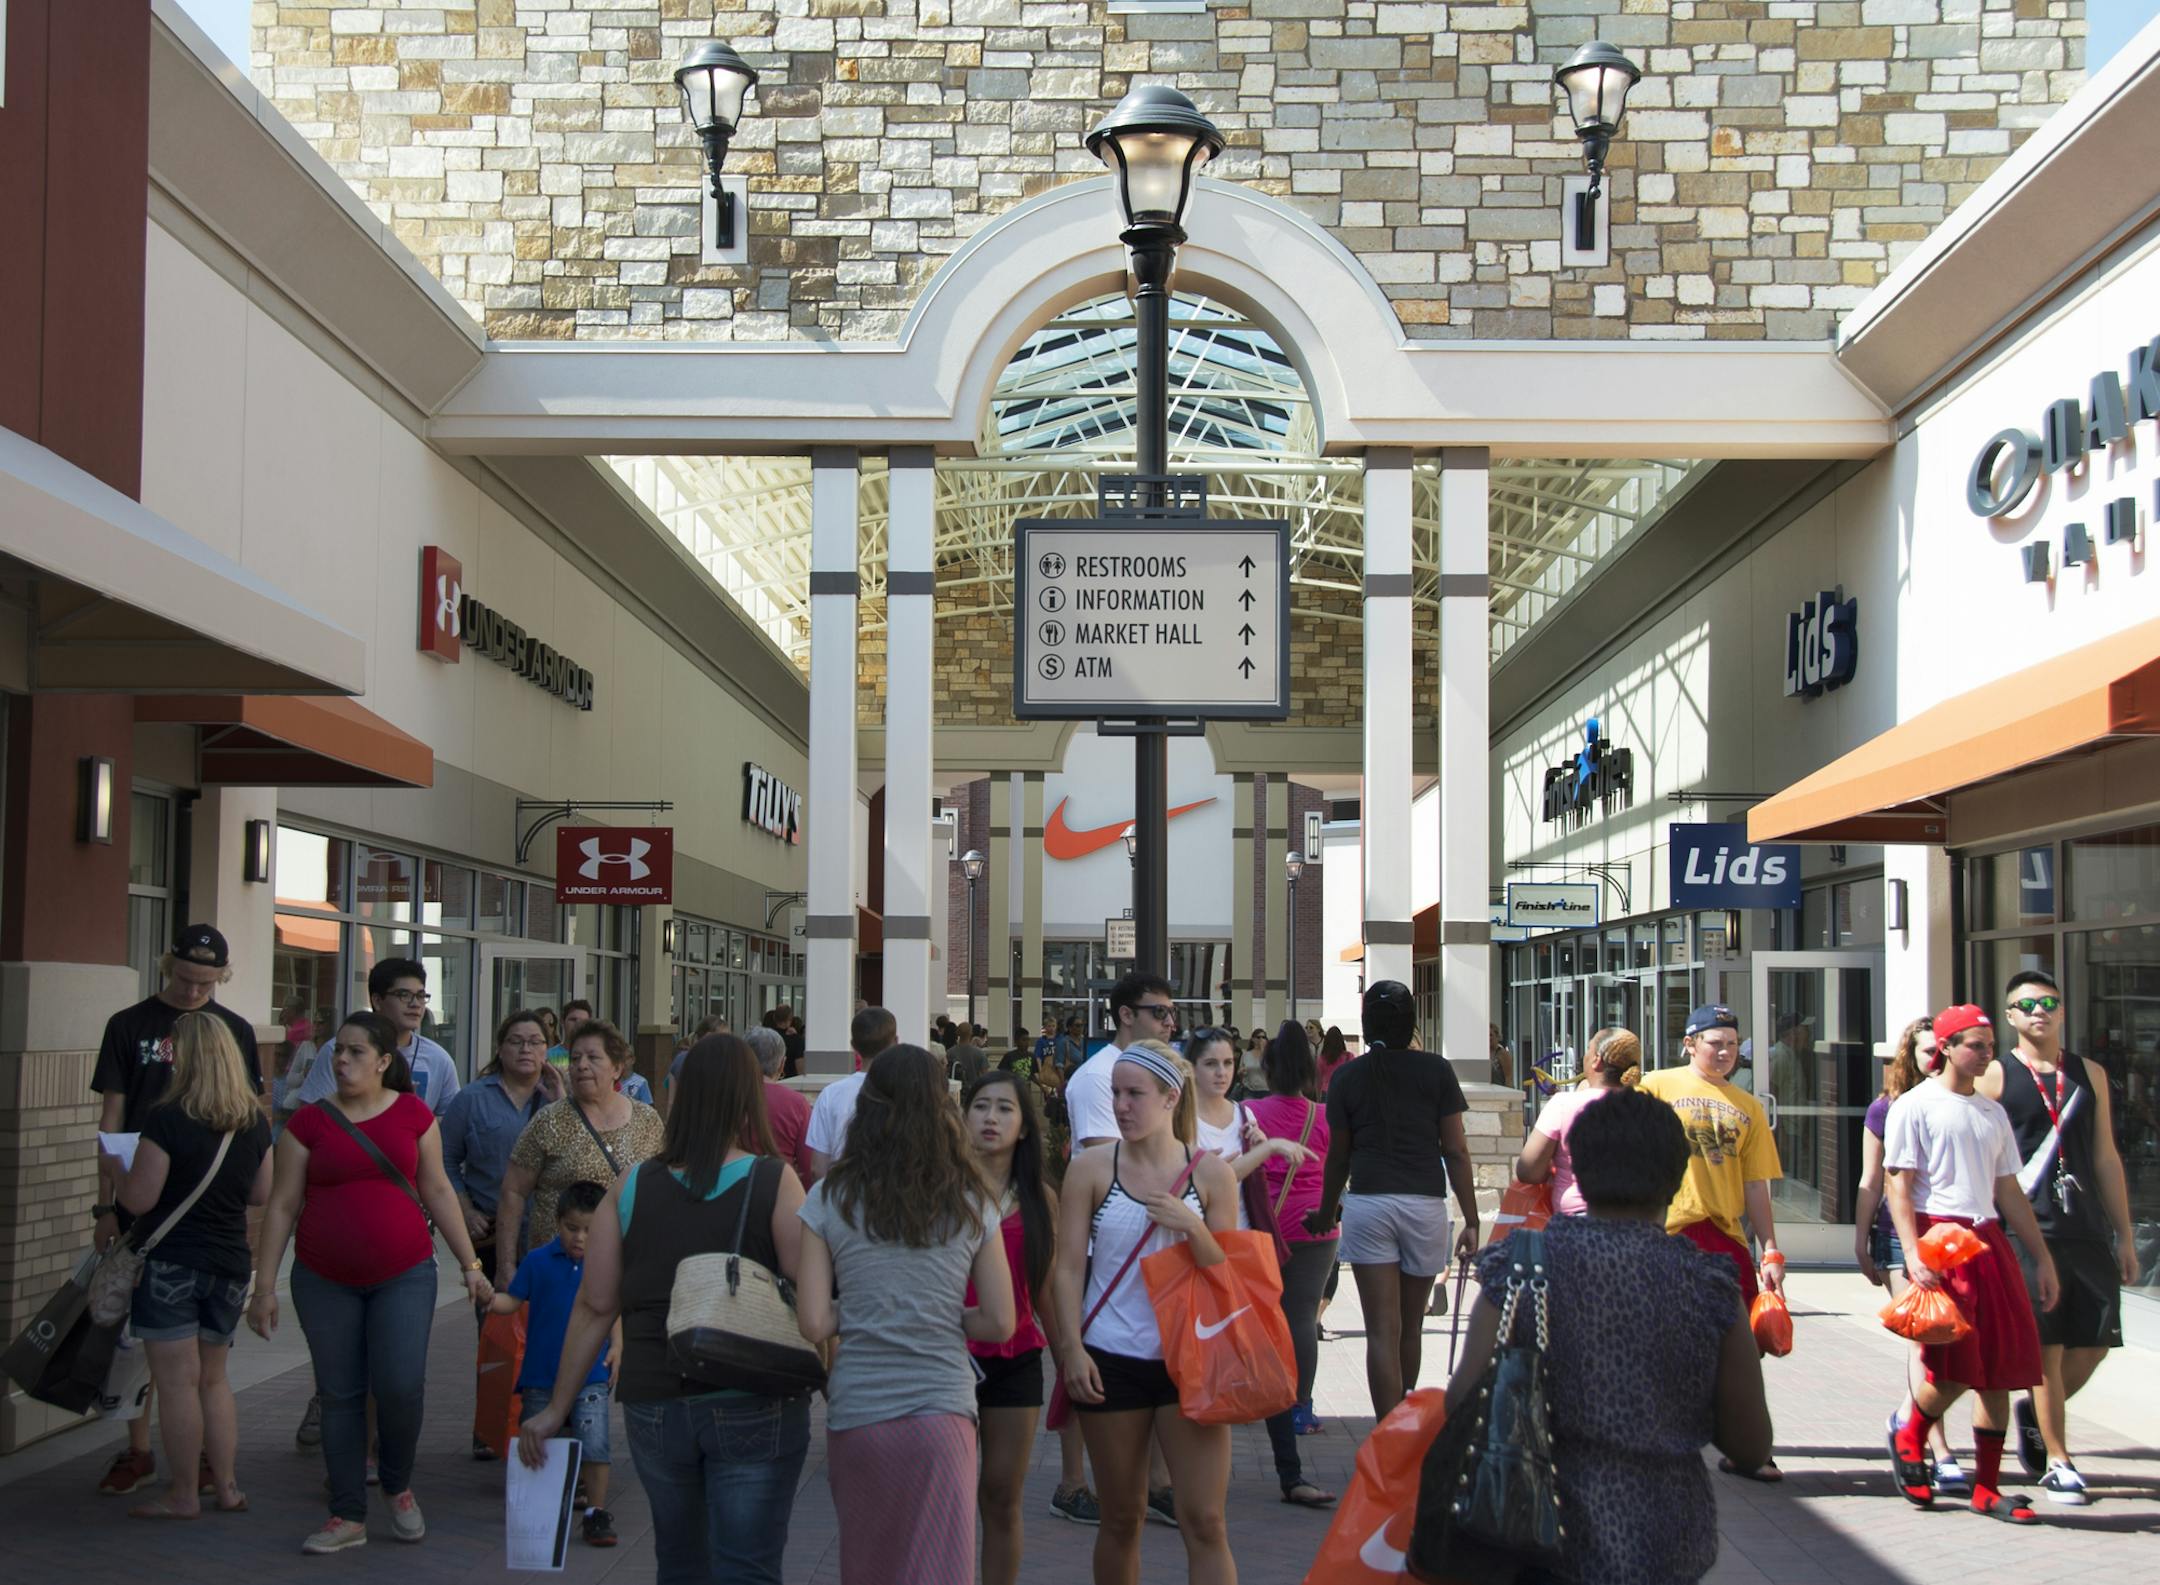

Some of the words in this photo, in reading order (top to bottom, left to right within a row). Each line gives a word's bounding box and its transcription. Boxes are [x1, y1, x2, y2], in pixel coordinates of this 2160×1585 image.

[1076, 556, 1187, 578] RESTROOMS
[1076, 589, 1205, 611] INFORMATION
[1075, 623, 1150, 645] MARKET
[1156, 623, 1203, 645] HALL
[1784, 592, 1848, 697] Lids
[461, 594, 528, 677] UNDER
[528, 638, 594, 711] ARMOUR
[1074, 657, 1113, 678] ATM
[1684, 846, 1787, 885] Lids
[565, 886, 607, 895] UNDER
[609, 886, 663, 895] ARMOUR
[1515, 900, 1555, 911] Finish
[1672, 1096, 1753, 1128] MINNESOTA
